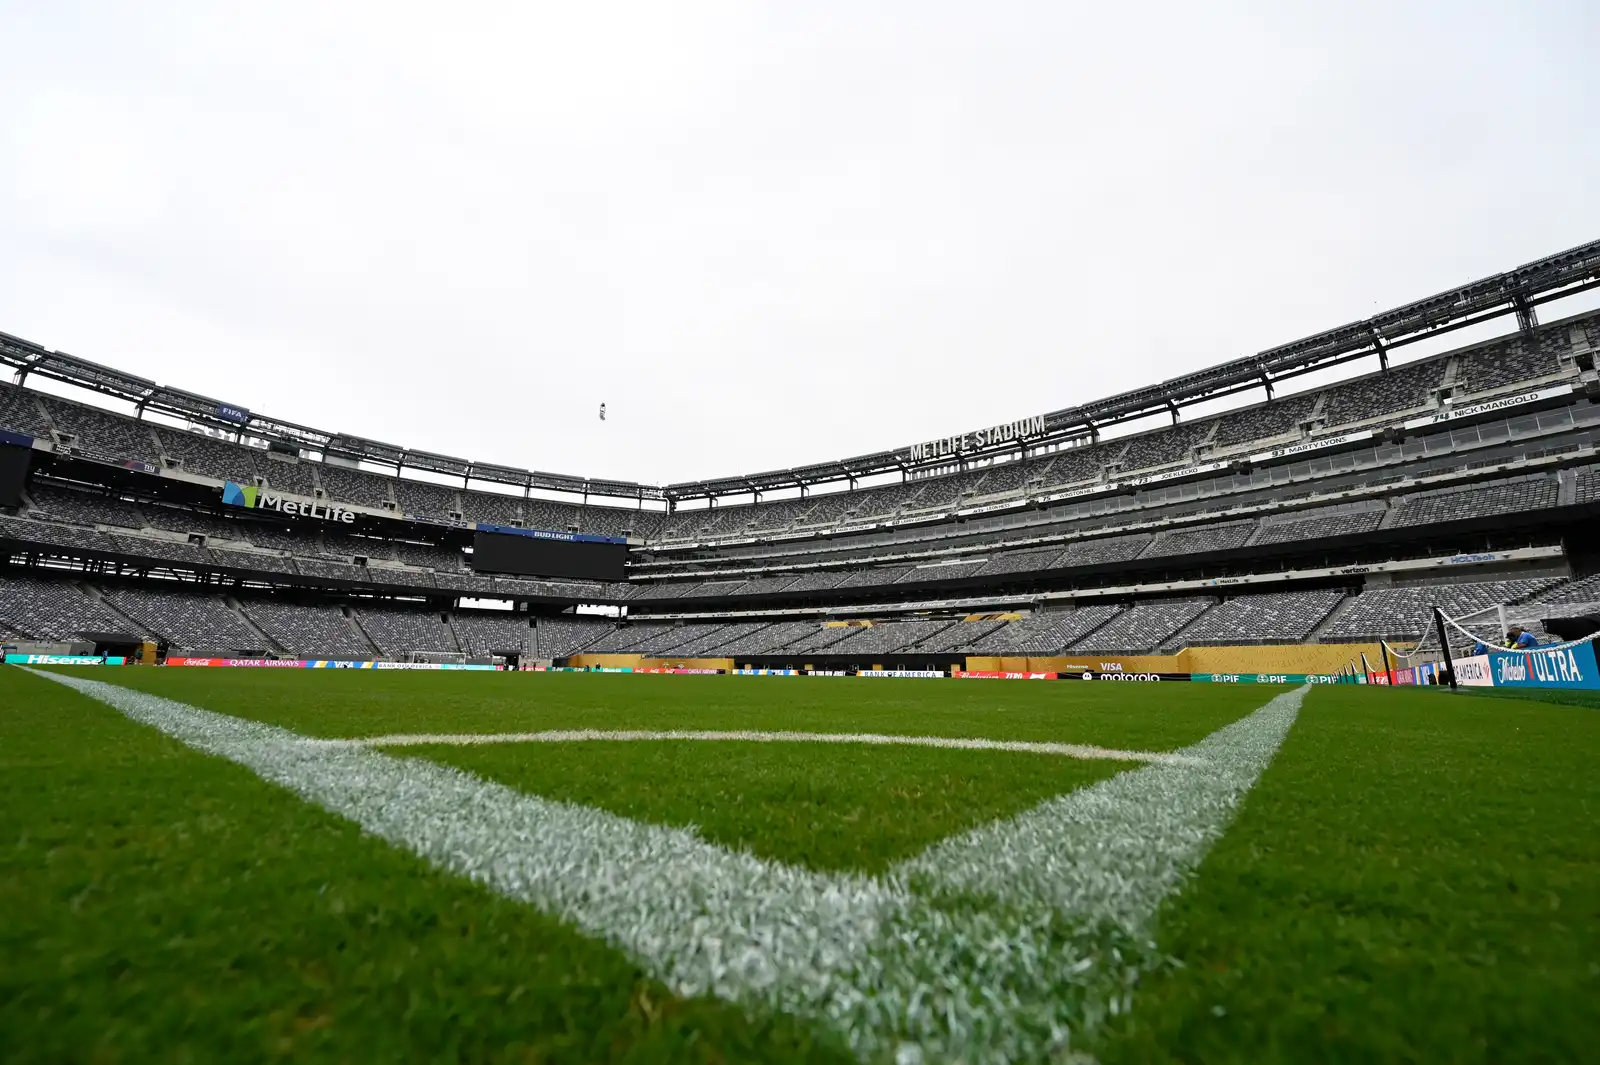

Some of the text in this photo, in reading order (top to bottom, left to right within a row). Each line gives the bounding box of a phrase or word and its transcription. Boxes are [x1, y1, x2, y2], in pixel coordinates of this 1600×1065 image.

[1454, 407, 1478, 418] NICK
[1480, 393, 1539, 411] MANGOLD
[222, 407, 242, 418] FIFA
[910, 415, 1045, 461] METLIFE STADIUM
[1272, 437, 1347, 458] 93 MARTY LYONS
[1161, 472, 1173, 480] JOE
[1174, 468, 1198, 477] KLECKO
[1059, 490, 1083, 499] WINSTON
[1083, 488, 1095, 496] HILL
[259, 493, 355, 523] MetLife
[534, 531, 575, 541] BUD LIGHT
[1451, 553, 1495, 564] HCLTech
[1341, 566, 1369, 575] verizon
[28, 655, 101, 665] Hisense
[230, 659, 260, 667] QATAR
[1100, 663, 1122, 671] VISA
[1498, 650, 1582, 683] Michelob ULTRA
[1100, 673, 1160, 682] motorola
[1223, 675, 1240, 683] PIF
[1269, 675, 1287, 683] PIF
